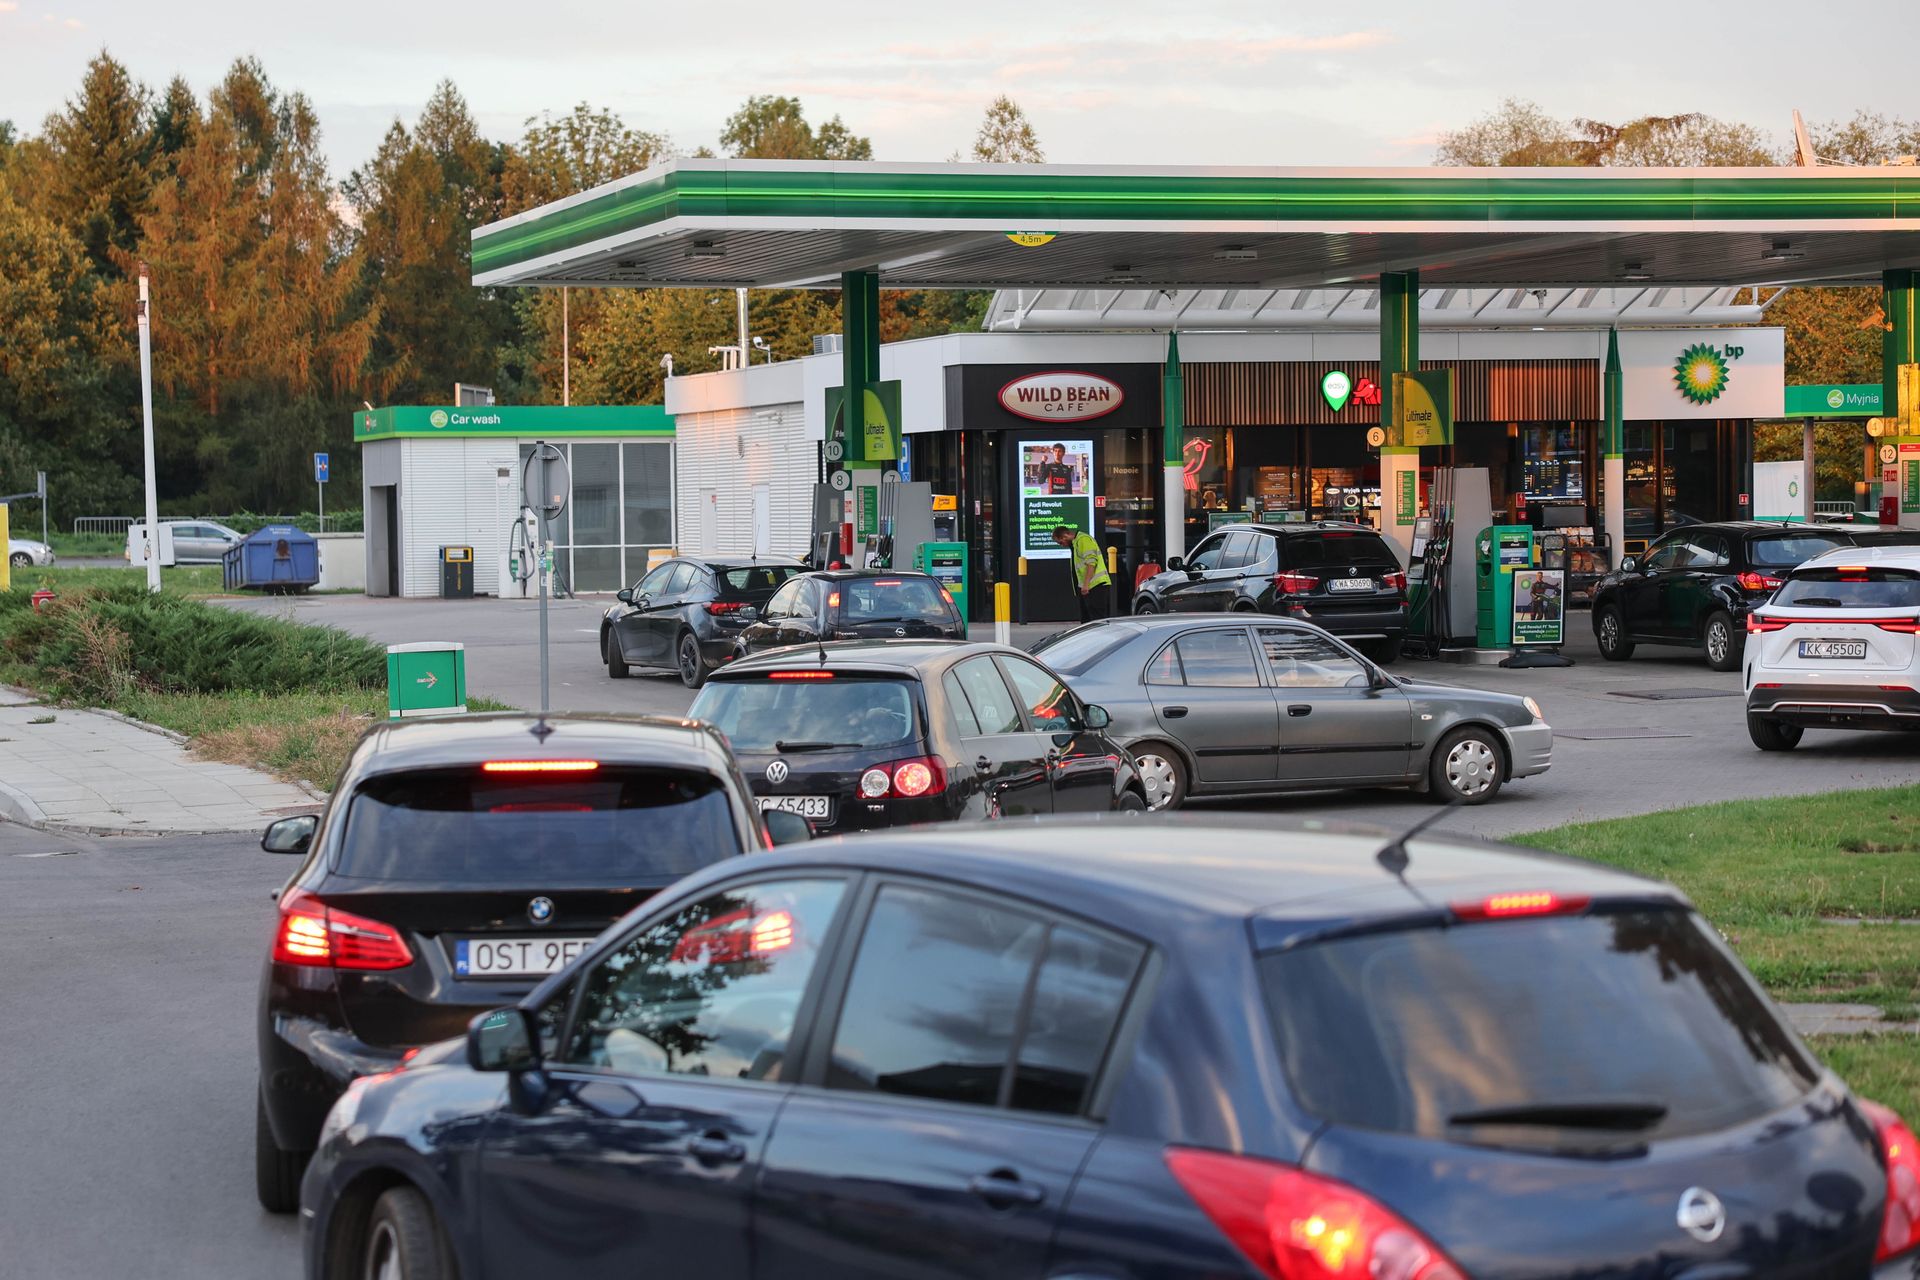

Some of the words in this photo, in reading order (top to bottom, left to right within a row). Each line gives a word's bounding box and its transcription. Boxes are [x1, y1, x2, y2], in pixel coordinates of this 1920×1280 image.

[1725, 343, 1744, 359] bp
[1327, 382, 1346, 390] easy
[1017, 387, 1062, 402] WILD
[1066, 386, 1110, 401] BEAN
[1846, 393, 1879, 406] Myjnia
[1044, 403, 1084, 411] CAFE
[451, 414, 470, 424] Car
[471, 414, 501, 424] wash
[1373, 432, 1379, 442] 6
[828, 445, 839, 456] 10
[1883, 449, 1894, 459] 12
[836, 474, 843, 485] 8
[889, 474, 895, 482] 7
[1334, 580, 1348, 588] KWA
[1807, 643, 1821, 655] KK
[1826, 643, 1862, 655] 4550G
[776, 797, 827, 815] 65433
[867, 804, 885, 812] TDI
[476, 943, 532, 970] OST
